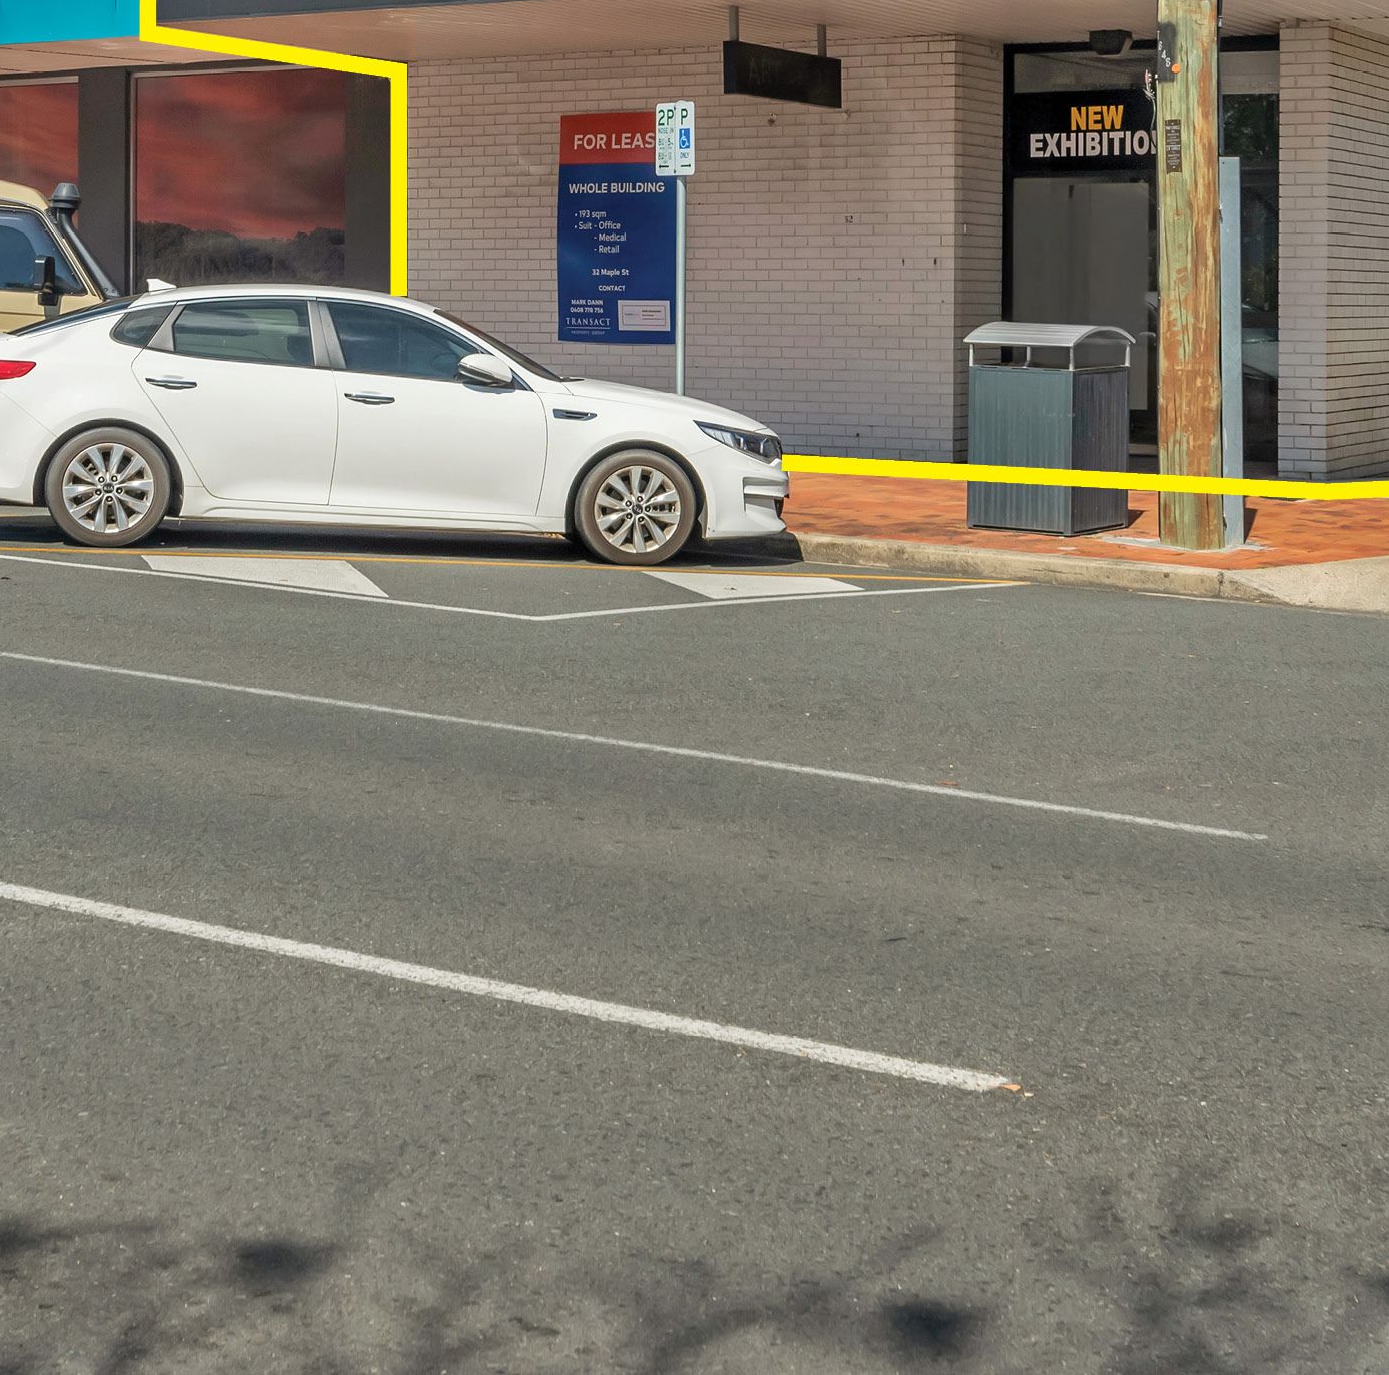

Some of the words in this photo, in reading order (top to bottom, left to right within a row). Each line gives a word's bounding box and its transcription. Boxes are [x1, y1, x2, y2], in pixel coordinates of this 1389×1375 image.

[658, 109, 675, 126] 2P
[681, 108, 688, 125] P
[1070, 105, 1124, 131] NEW
[574, 134, 606, 150] FOR
[611, 133, 656, 150] LEAS
[569, 183, 608, 194] WHOLE
[611, 182, 665, 193] BUILDING
[579, 210, 590, 218] 193
[591, 211, 606, 220] sqm
[578, 221, 592, 230] Suit
[599, 220, 621, 230] Office
[599, 232, 627, 242] Medical
[599, 245, 620, 254] Retail
[601, 269, 620, 277] Maple
[566, 317, 611, 326] TRANSACT
